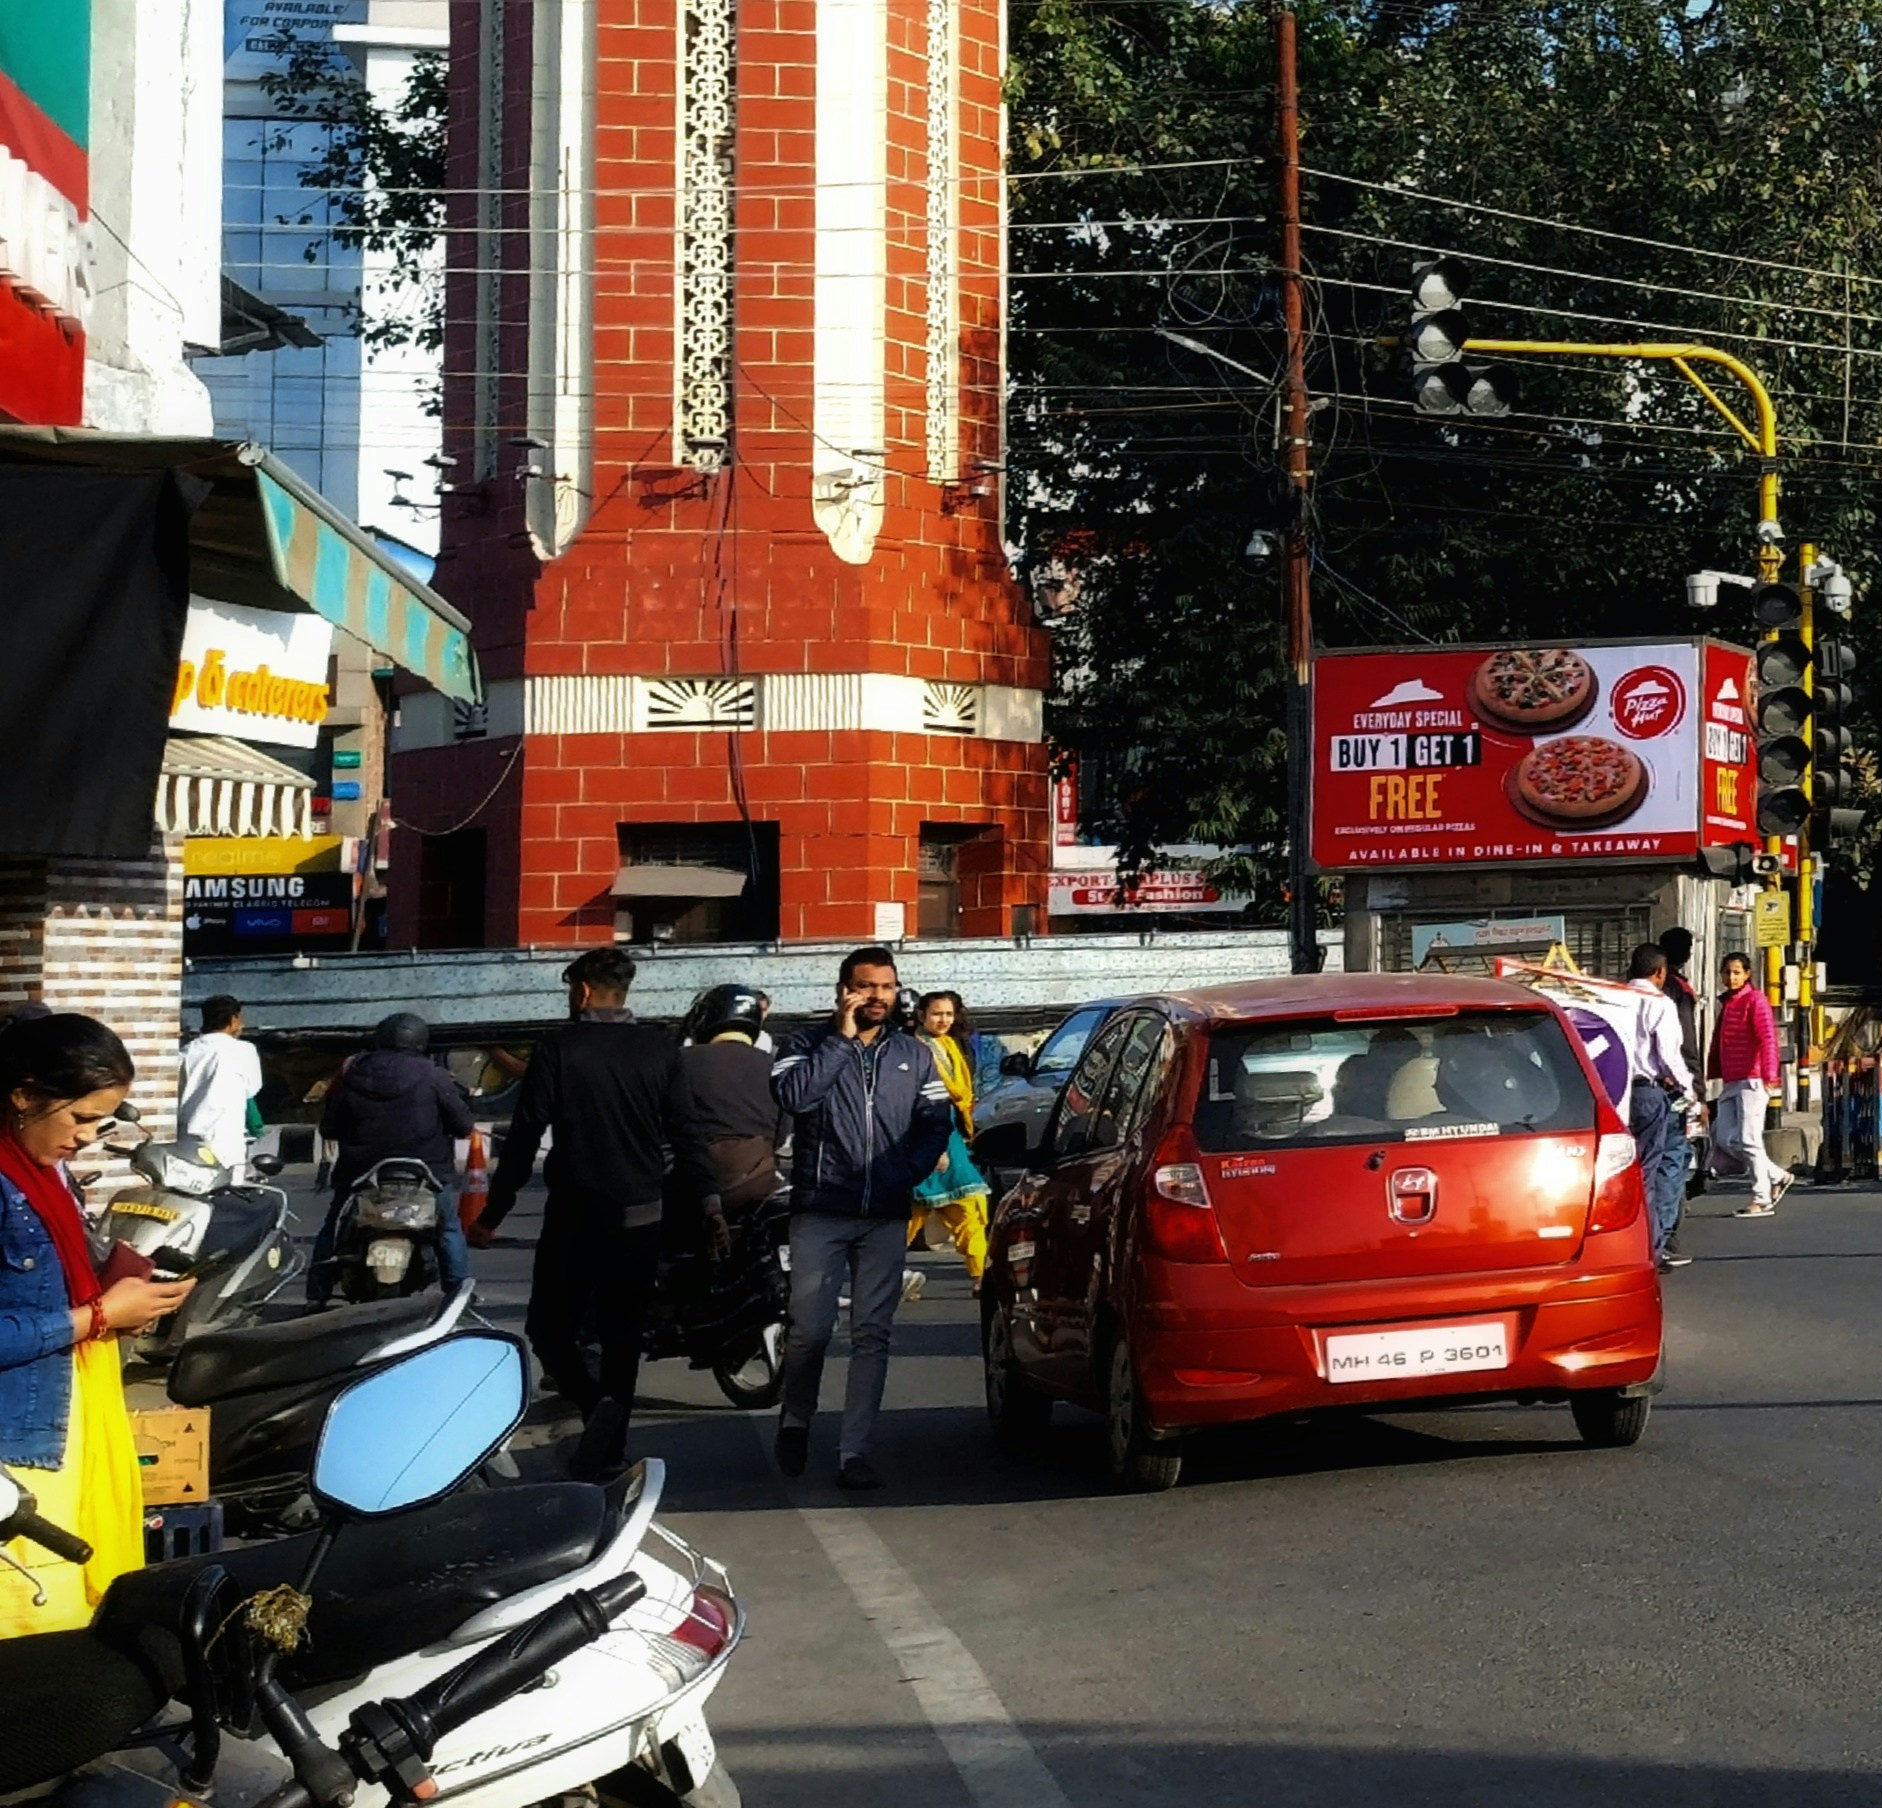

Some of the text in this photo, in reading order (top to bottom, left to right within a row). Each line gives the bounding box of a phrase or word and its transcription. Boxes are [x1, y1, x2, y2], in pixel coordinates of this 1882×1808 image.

[265, 2, 344, 14] AVAILABLE
[240, 15, 270, 27] FOR
[226, 664, 330, 725] caterers
[1624, 696, 1668, 717] Pizza
[1353, 710, 1463, 729] EVERYDAY SPECIAL
[1631, 709, 1665, 728] Hut
[1338, 735, 1473, 768] BUY 1 GET 1
[1369, 773, 1442, 820] FREE
[191, 847, 283, 866] realme
[1349, 848, 1440, 860] AVAILABLE
[1448, 847, 1466, 857] IN
[1474, 843, 1543, 858] DINE-IN
[1572, 839, 1661, 853] TAKEAWAY
[185, 877, 305, 898] AMSUNG
[1441, 1123, 1499, 1136] HYUNDAI
[1332, 1344, 1503, 1370] MH 46 P 3601
